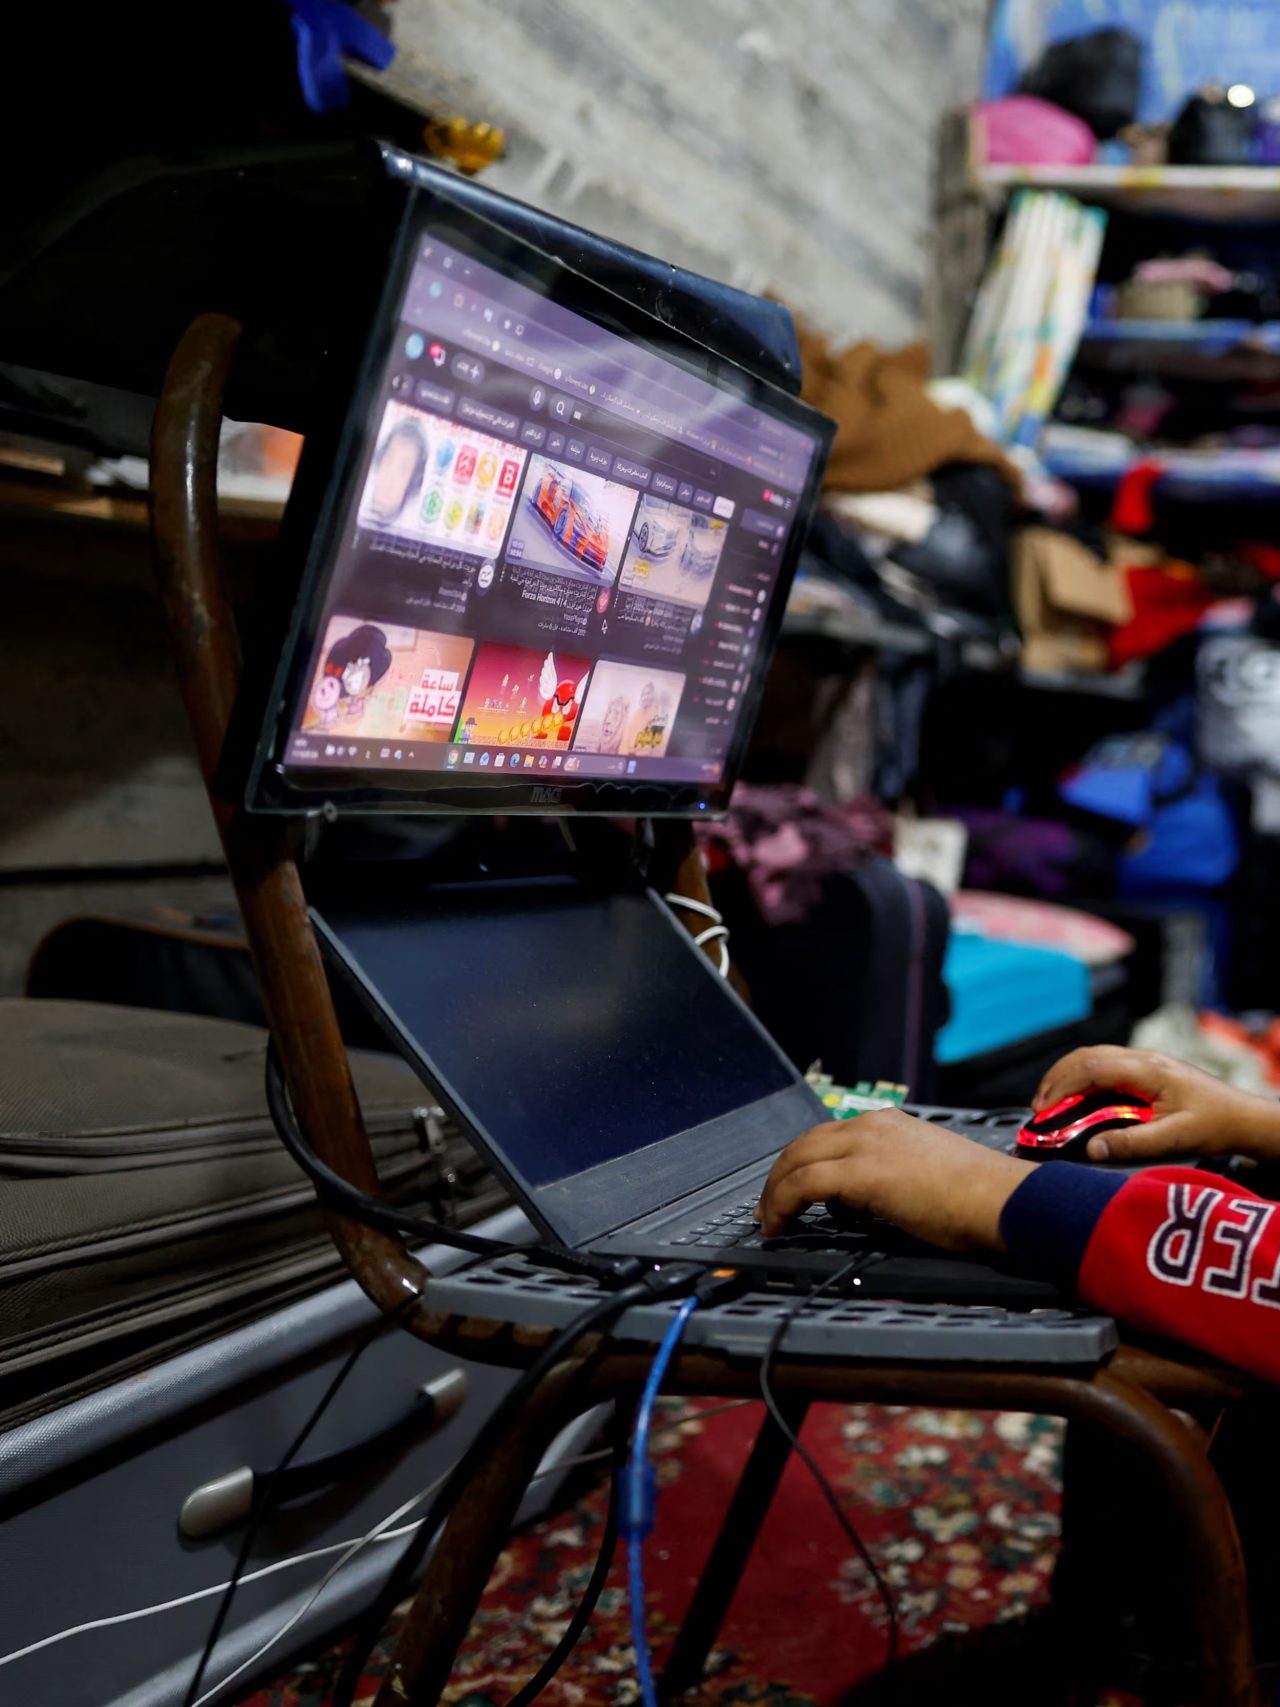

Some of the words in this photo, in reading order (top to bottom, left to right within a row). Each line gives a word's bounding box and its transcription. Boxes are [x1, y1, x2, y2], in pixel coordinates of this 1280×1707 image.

[522, 589, 537, 600] Forza
[537, 593, 556, 604] Horizon
[421, 675, 454, 692] ساعة
[410, 694, 456, 717] كاملة
